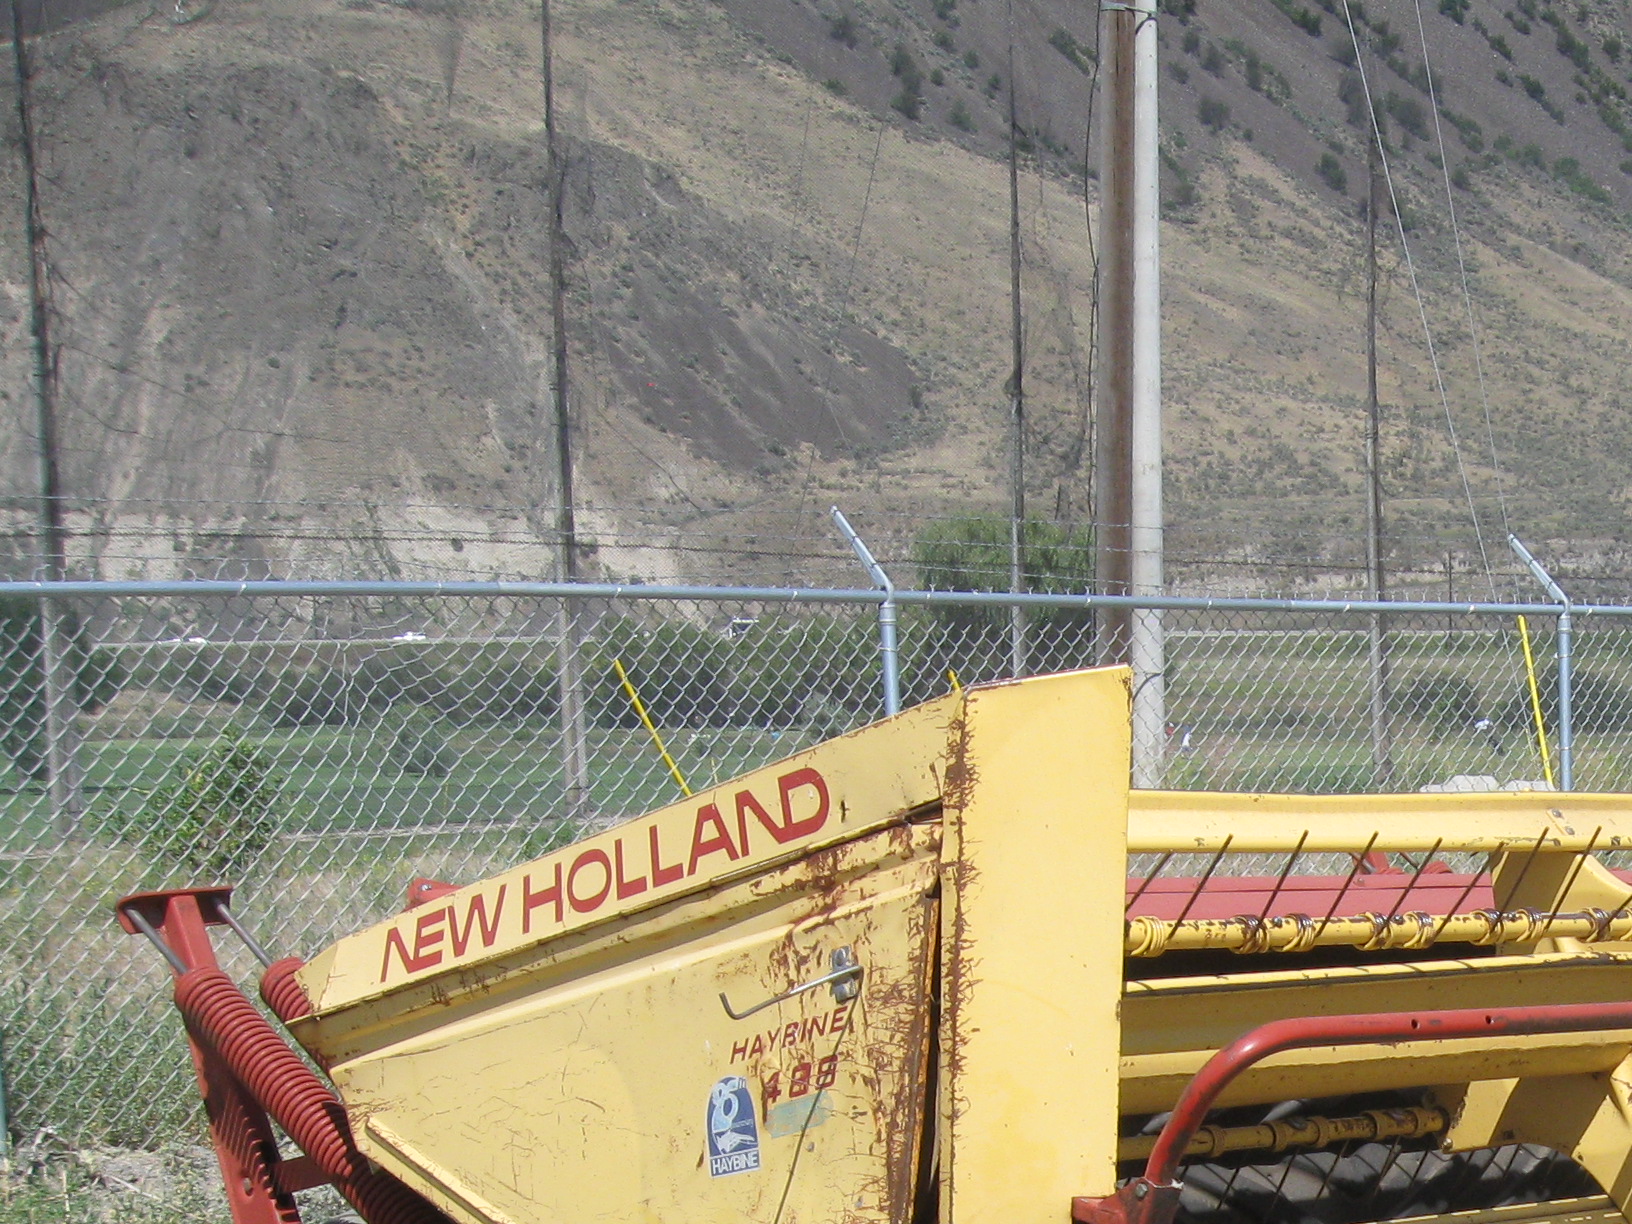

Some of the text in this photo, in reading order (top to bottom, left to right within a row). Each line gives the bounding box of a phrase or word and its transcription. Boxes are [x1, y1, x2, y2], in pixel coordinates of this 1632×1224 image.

[380, 767, 830, 983] NEW HOLLAND
[730, 1005, 849, 1064] HAYBINE
[765, 1054, 838, 1104] 488
[711, 1151, 758, 1175] HAYBINE
